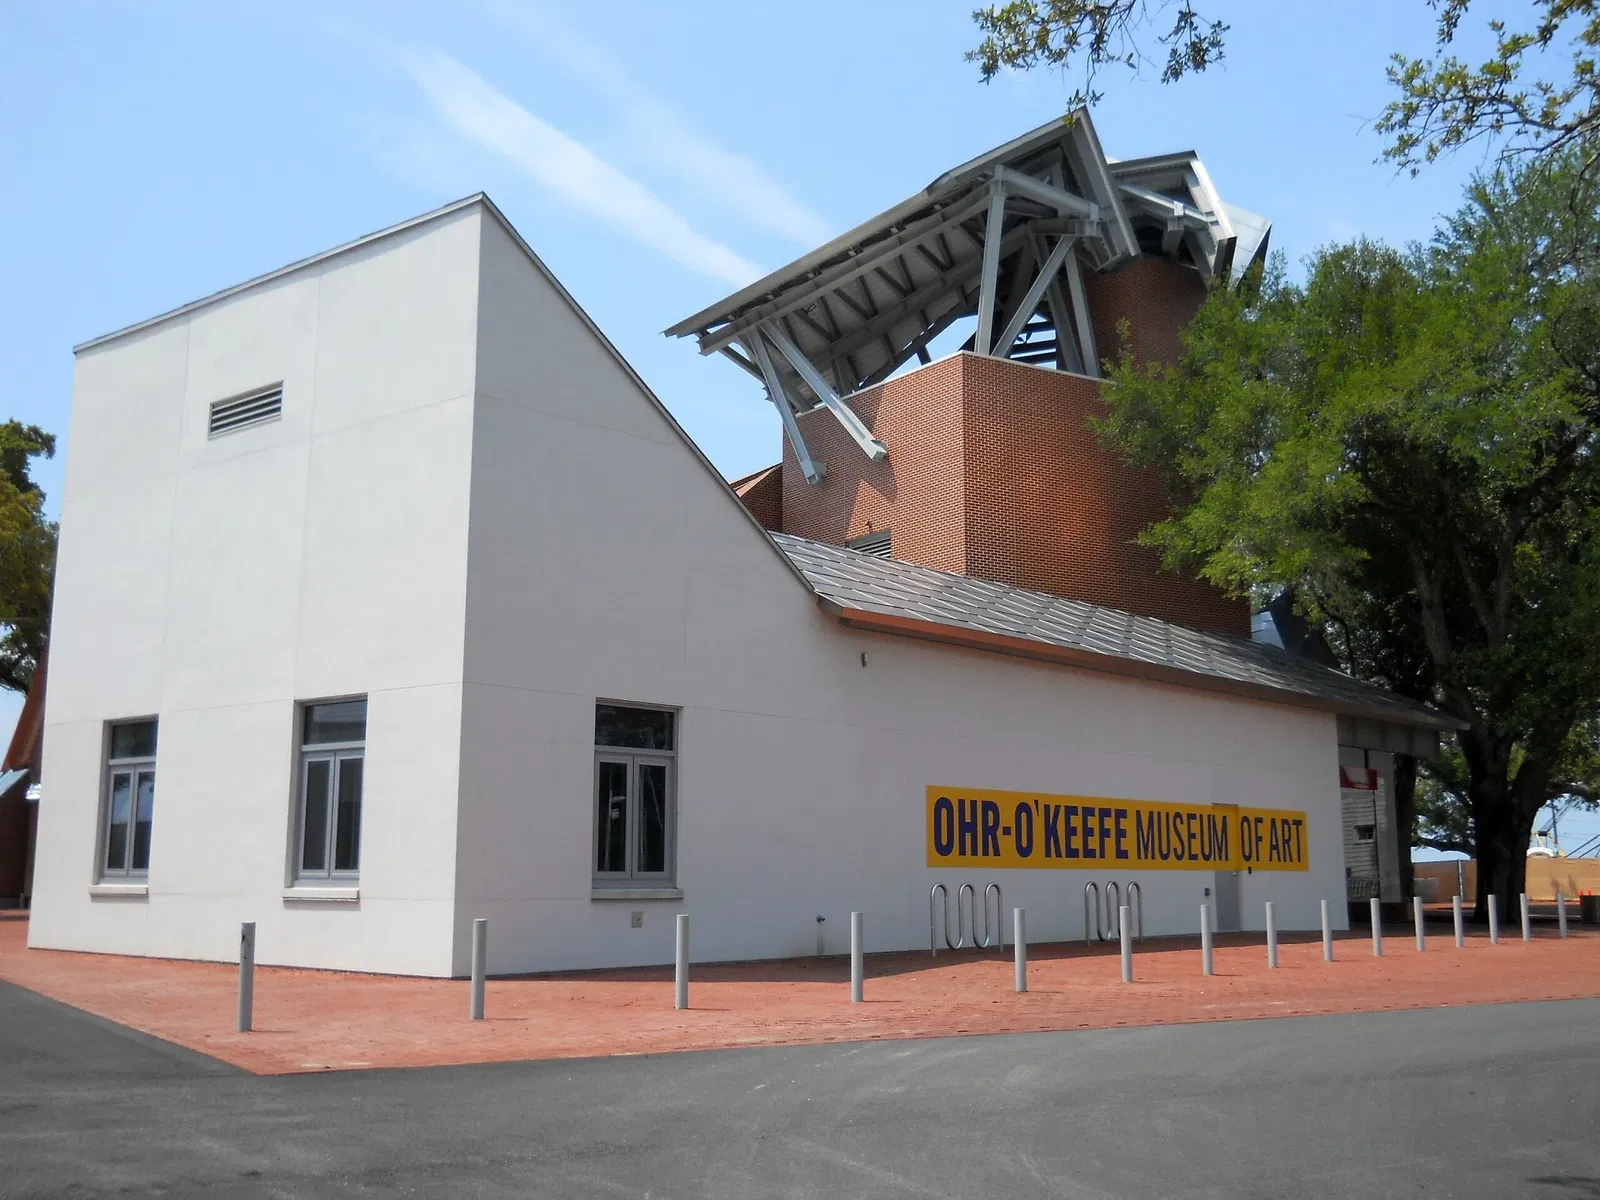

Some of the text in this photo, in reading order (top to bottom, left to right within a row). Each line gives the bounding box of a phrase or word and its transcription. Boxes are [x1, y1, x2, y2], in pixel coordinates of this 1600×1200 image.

[1135, 809, 1229, 862] MUSEUM
[1240, 816, 1264, 862] OF
[1268, 817, 1303, 863] ART
